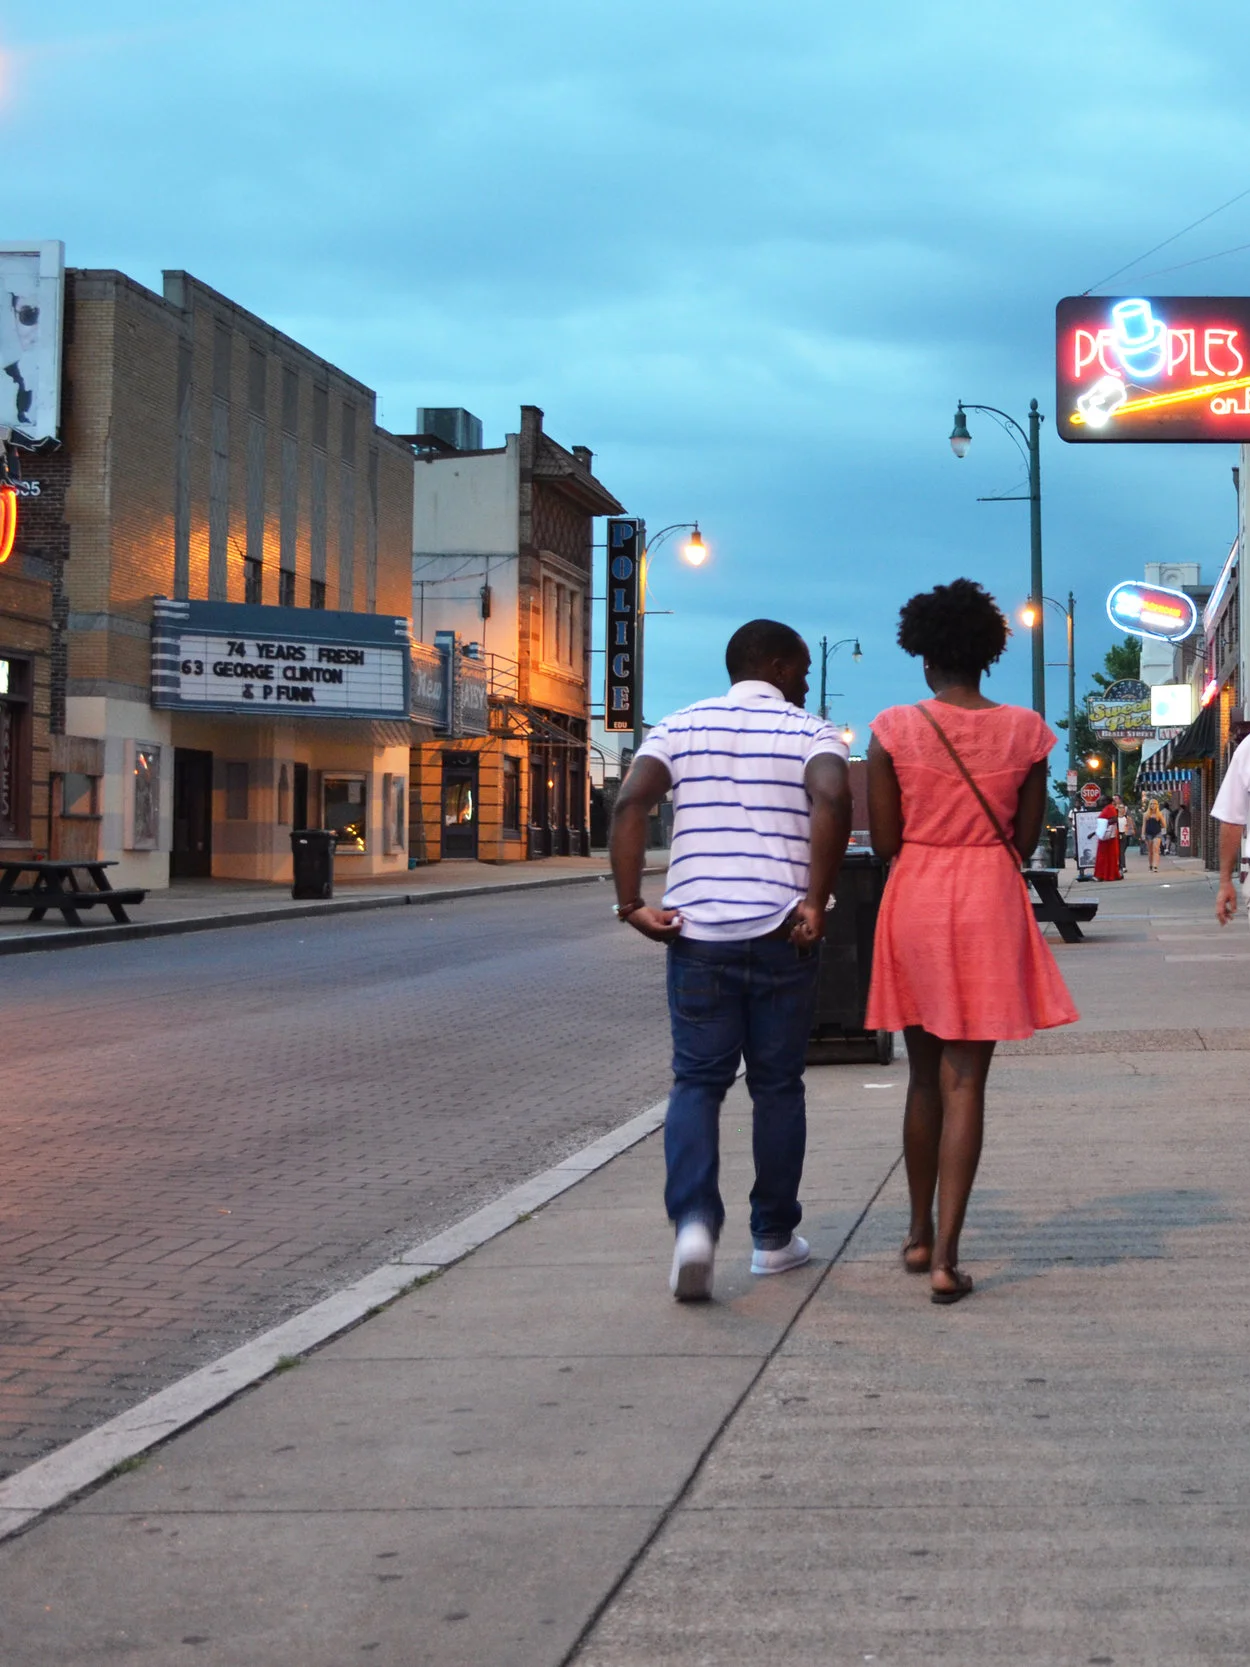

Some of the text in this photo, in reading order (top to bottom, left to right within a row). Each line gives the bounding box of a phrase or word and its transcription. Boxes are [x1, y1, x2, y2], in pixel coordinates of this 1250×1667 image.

[1074, 327, 1244, 378] PEOPLES
[1210, 397, 1239, 415] on
[611, 523, 633, 711] POLICE
[226, 641, 365, 666] 74 YEARS FRESH
[181, 660, 343, 685] 63 GEORGE CLINTON
[263, 684, 274, 701] P
[276, 685, 316, 703] FUNK
[613, 721, 628, 729] EDU
[1101, 730, 1155, 738] BEALE STREET
[1082, 789, 1099, 797] STOP
[1181, 827, 1190, 846] ATM
